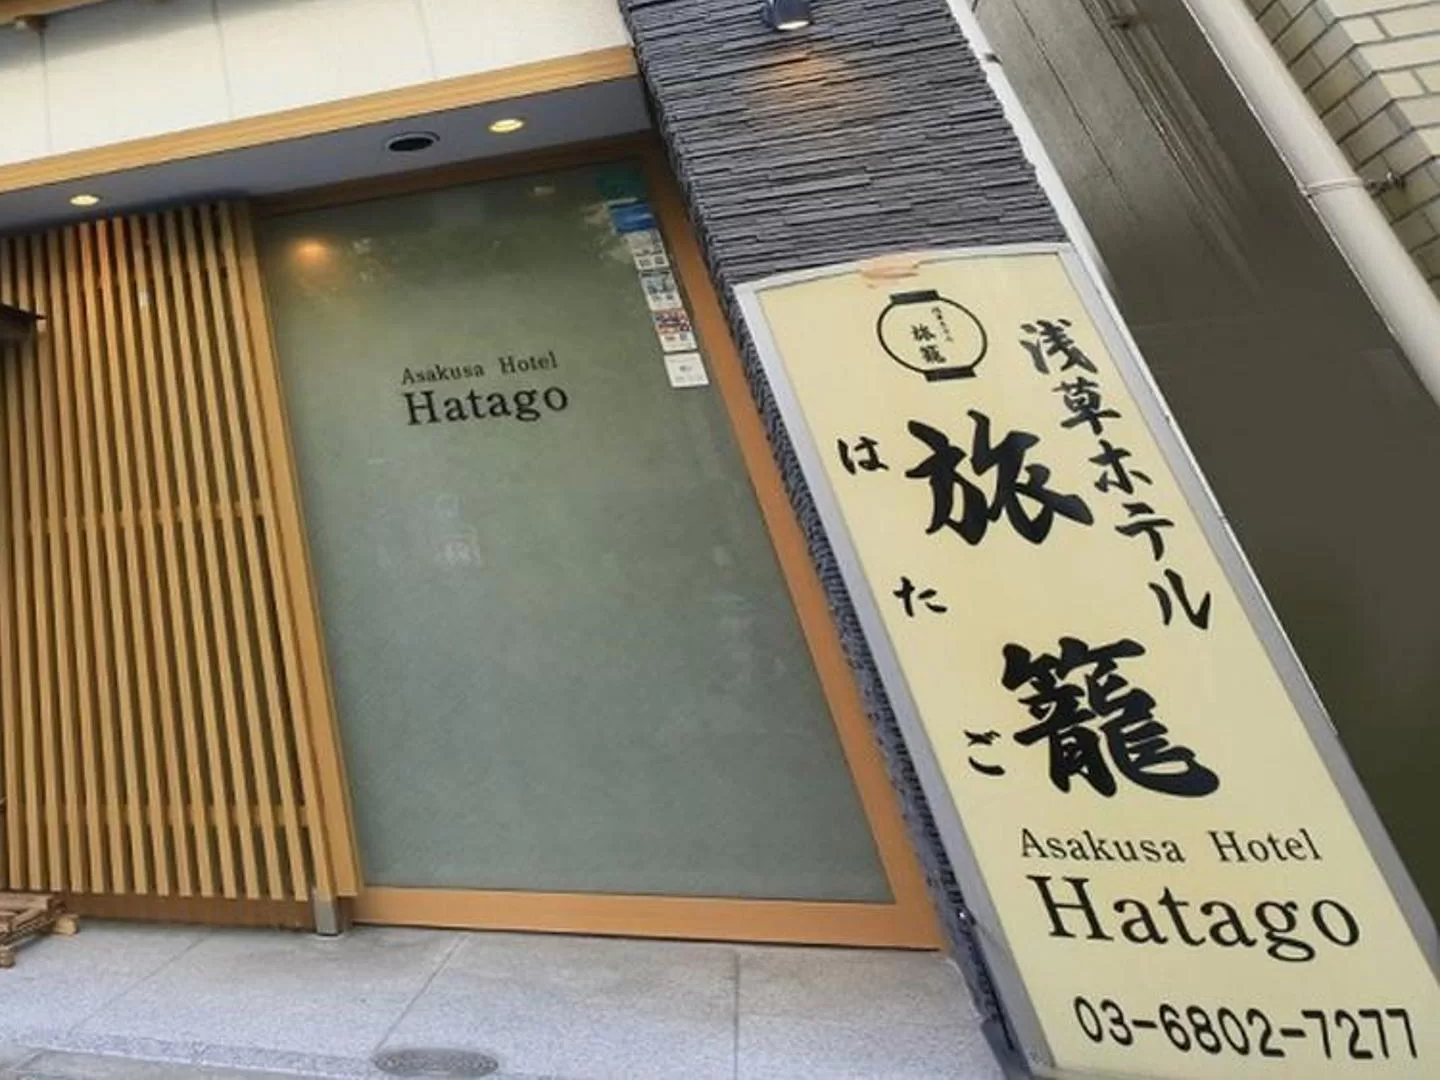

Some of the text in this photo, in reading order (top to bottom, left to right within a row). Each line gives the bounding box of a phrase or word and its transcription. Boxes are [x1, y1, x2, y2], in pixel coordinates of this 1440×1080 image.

[402, 350, 558, 385] Asakusa Hotel
[404, 385, 569, 425] Hatago
[1019, 319, 1211, 630] 浅草ホテル
[904, 409, 1220, 798] 旅籠
[1019, 827, 1323, 864] Asakusa Hotel
[1027, 873, 1360, 963] Hatago
[1073, 996, 1418, 1060] 03-6802-7277
